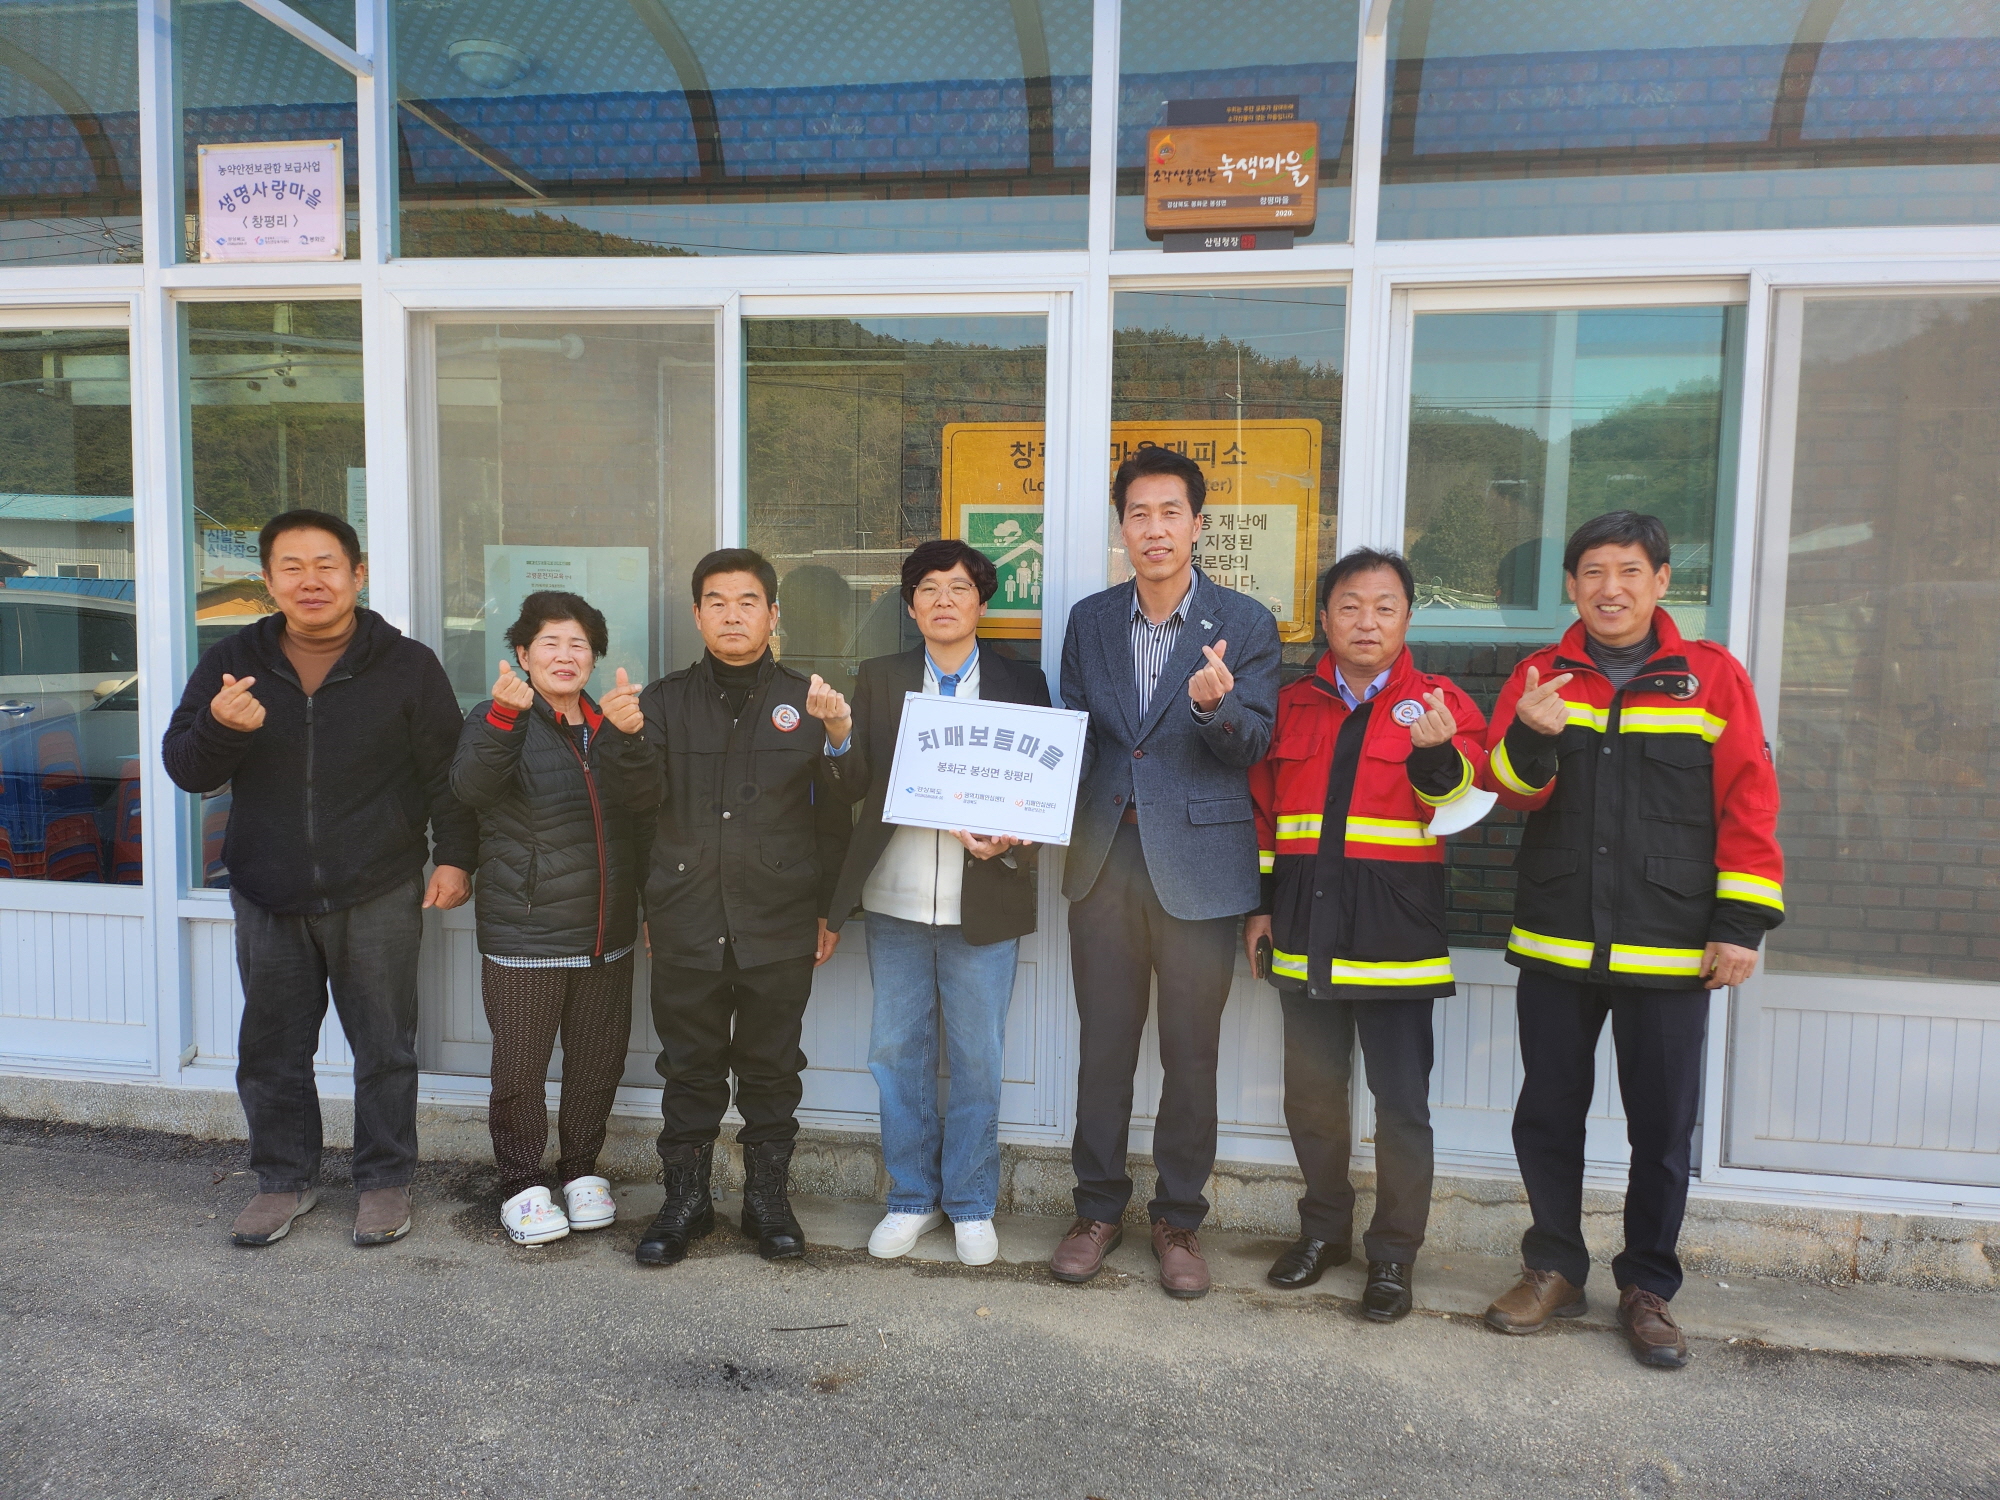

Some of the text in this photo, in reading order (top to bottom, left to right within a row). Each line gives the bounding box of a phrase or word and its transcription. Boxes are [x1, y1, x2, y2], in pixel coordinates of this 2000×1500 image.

[218, 161, 320, 176] 농약안전보관함 보급사업
[1217, 150, 1309, 187] 녹색마을
[218, 180, 321, 213] 생명사랑마을
[1219, 513, 1267, 531] 재난에
[208, 529, 246, 543] 신발은
[1205, 534, 1252, 551] 지정된
[208, 543, 260, 558] 신발장으
[1271, 604, 1282, 612] 63
[918, 725, 1064, 771] 치매보듬마을
[937, 761, 1034, 783] 봉화군 봉성면 창평리
